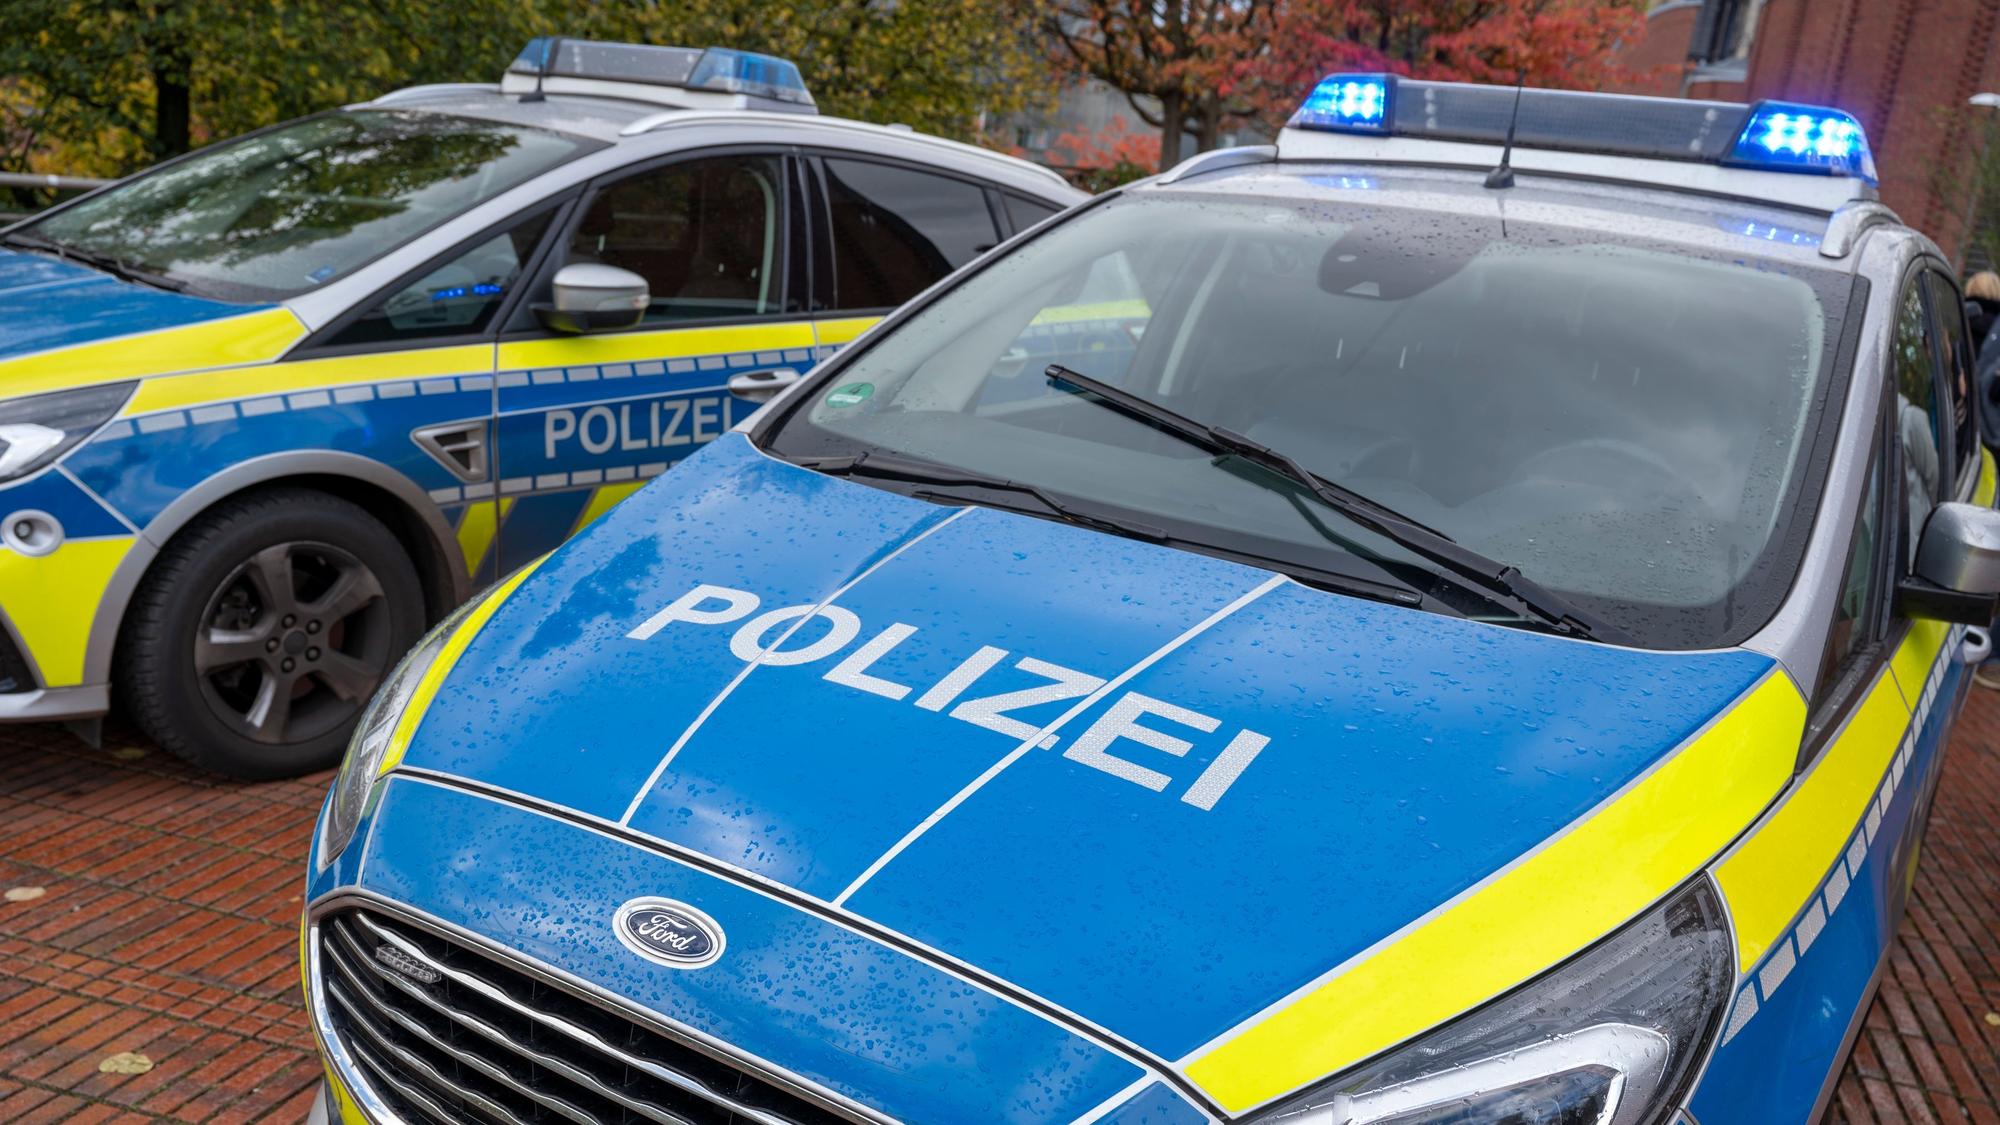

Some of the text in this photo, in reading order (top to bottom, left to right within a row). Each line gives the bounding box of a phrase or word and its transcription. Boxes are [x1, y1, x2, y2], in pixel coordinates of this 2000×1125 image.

[545, 397, 732, 458] POLIZEI
[626, 584, 1271, 812] POLIZEI
[639, 914, 697, 950] Ford
